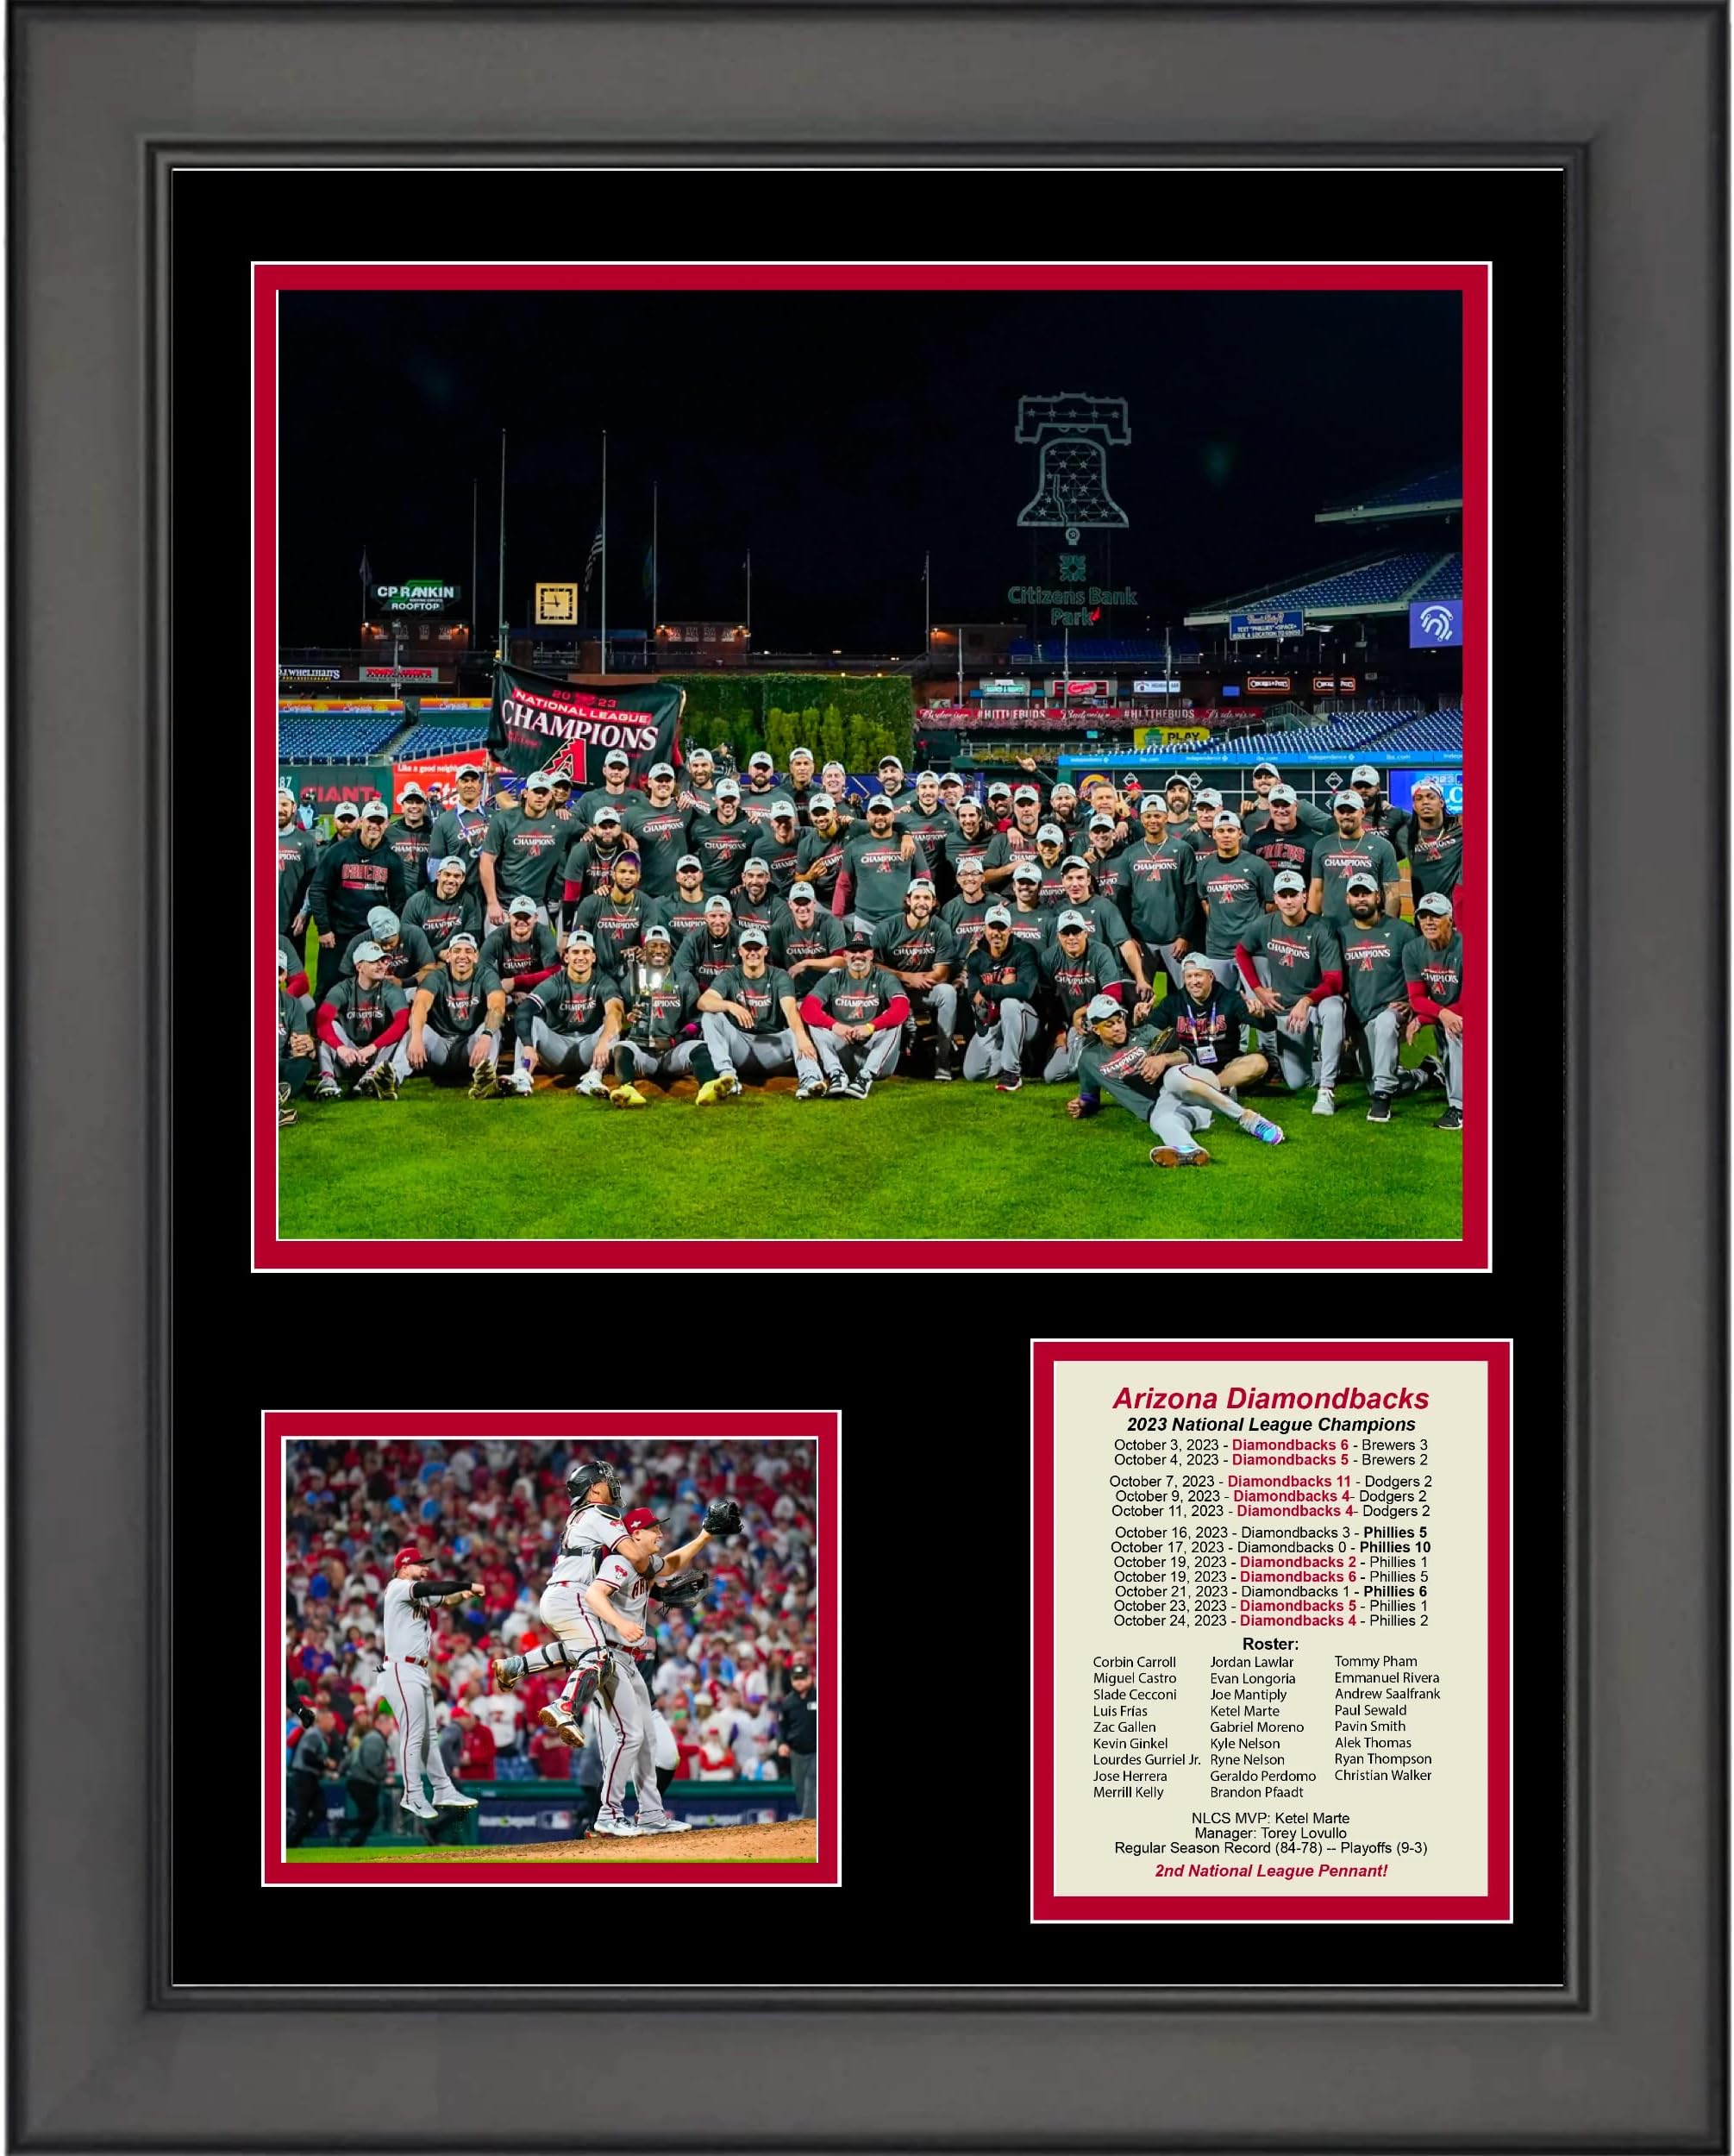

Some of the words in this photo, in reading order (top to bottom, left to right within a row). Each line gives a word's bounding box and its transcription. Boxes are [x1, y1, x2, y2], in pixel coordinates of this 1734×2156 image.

[377, 586, 398, 598] CP
[399, 586, 454, 598] RANKIN
[1007, 586, 1086, 605] Citizens
[1088, 586, 1138, 605] Bank
[1050, 607, 1094, 626] Park
[516, 691, 586, 718] NATIONAL
[591, 710, 650, 724] LEAGUE
[598, 698, 617, 708] 23
[502, 699, 659, 751] CHAMPIONS
[1167, 731, 1200, 742] PLAY
[420, 765, 435, 774] good
[643, 821, 684, 833] CHAMPIONS
[513, 837, 555, 846] CHAMPIONS
[704, 842, 747, 850] CHAMPIONS
[861, 856, 903, 864] CHAMPION
[1134, 862, 1177, 870] CHAMPIONS
[1324, 858, 1372, 868] CHAMPIONS
[1206, 882, 1249, 892] CHAMPIONS
[598, 920, 640, 929] CHAMPIONS
[668, 919, 706, 928] CHAMPION
[893, 946, 936, 956] CHAMPIONS
[1268, 941, 1310, 959] CHAMPIONS
[1345, 950, 1390, 960] CHAMPIONS
[835, 997, 880, 1007] CHAMPIONS
[1111, 1387, 1218, 1410] Arizona
[1226, 1387, 1430, 1410] Diamondbacks
[1126, 1417, 1167, 1432] 2023
[1171, 1417, 1245, 1432] National
[1248, 1417, 1313, 1435] League
[1318, 1417, 1417, 1435] Champions
[1114, 1438, 1167, 1451] October
[1170, 1438, 1182, 1453] 3,
[1186, 1438, 1219, 1451] 2023
[1232, 1438, 1336, 1451] Diamondbacks
[1340, 1438, 1349, 1451] 6
[1362, 1438, 1416, 1451] Brewers
[1419, 1438, 1429, 1451] 3
[1109, 1475, 1162, 1488] October
[1165, 1475, 1178, 1489] 7,
[1182, 1475, 1215, 1488] 2023
[1228, 1475, 1332, 1488] Diamondbacks
[1336, 1475, 1350, 1488] 11
[1365, 1475, 1421, 1490] Dodgers
[1424, 1475, 1432, 1488] 2
[1111, 1540, 1164, 1553] October
[1167, 1540, 1187, 1555] 17,
[1191, 1540, 1224, 1553] 2023
[1237, 1540, 1334, 1553] Diamondbacks
[1338, 1540, 1347, 1553] 0
[1360, 1540, 1411, 1553] Phillies
[1415, 1540, 1431, 1553] 10
[1113, 1614, 1167, 1626] October
[1169, 1614, 1190, 1629] 24,
[1194, 1614, 1227, 1626] 2023
[1240, 1614, 1344, 1626] Diamondbacks
[1348, 1614, 1357, 1626] 4
[1369, 1614, 1416, 1626] Phillies
[1420, 1614, 1429, 1626] 2
[1243, 1637, 1299, 1651] Roster:
[1092, 1656, 1134, 1668] Corbin
[1136, 1656, 1176, 1668] Carroll
[1210, 1656, 1251, 1668] Jordan
[1255, 1656, 1294, 1668] Lawlar
[1334, 1655, 1380, 1670] Tommy
[1383, 1655, 1418, 1667] Pham
[1093, 1688, 1127, 1701] Slade
[1129, 1689, 1177, 1701] Cecconi
[1210, 1689, 1231, 1701] Joe
[1234, 1688, 1287, 1703] Mantiply
[1335, 1687, 1383, 1700] Andrew
[1386, 1687, 1441, 1700] Saalfrank
[1092, 1721, 1116, 1733] Zac
[1117, 1720, 1156, 1733] Gallen
[1210, 1720, 1254, 1733] Gabriel
[1257, 1721, 1305, 1733] Moreno
[1335, 1720, 1368, 1732] Pavin
[1370, 1720, 1406, 1732] Smith
[1093, 1753, 1142, 1765] Lourdes
[1144, 1753, 1186, 1765] Gurriel
[1187, 1753, 1201, 1765] Jr.
[1211, 1753, 1241, 1768] Ryne
[1243, 1753, 1285, 1766] Nelson
[1335, 1752, 1364, 1767] Ryan
[1367, 1752, 1432, 1768] Thompson
[1093, 1786, 1132, 1798] Merrill
[1136, 1786, 1165, 1801] Kelly
[1211, 1786, 1261, 1798] Brandon
[1265, 1785, 1305, 1798] Pfaadt
[1192, 1812, 1231, 1824] NLCS
[1235, 1812, 1270, 1824] MVP:
[1275, 1812, 1309, 1824] Ketel
[1312, 1812, 1350, 1824] Marte
[1195, 1827, 1256, 1842] Manager:
[1260, 1827, 1297, 1842] Torey
[1300, 1827, 1348, 1839] Lovullo
[1115, 1841, 1167, 1857] Regular
[1170, 1841, 1220, 1854] Season
[1224, 1841, 1271, 1854] Record
[1275, 1841, 1323, 1857] (84-78)
[1341, 1841, 1393, 1857] Playoffs
[1396, 1841, 1428, 1857] (9-3)
[1155, 1864, 1186, 1877] 2nd
[1187, 1864, 1254, 1877] National
[1256, 1864, 1315, 1881] League
[1318, 1864, 1389, 1877] Pennant!
